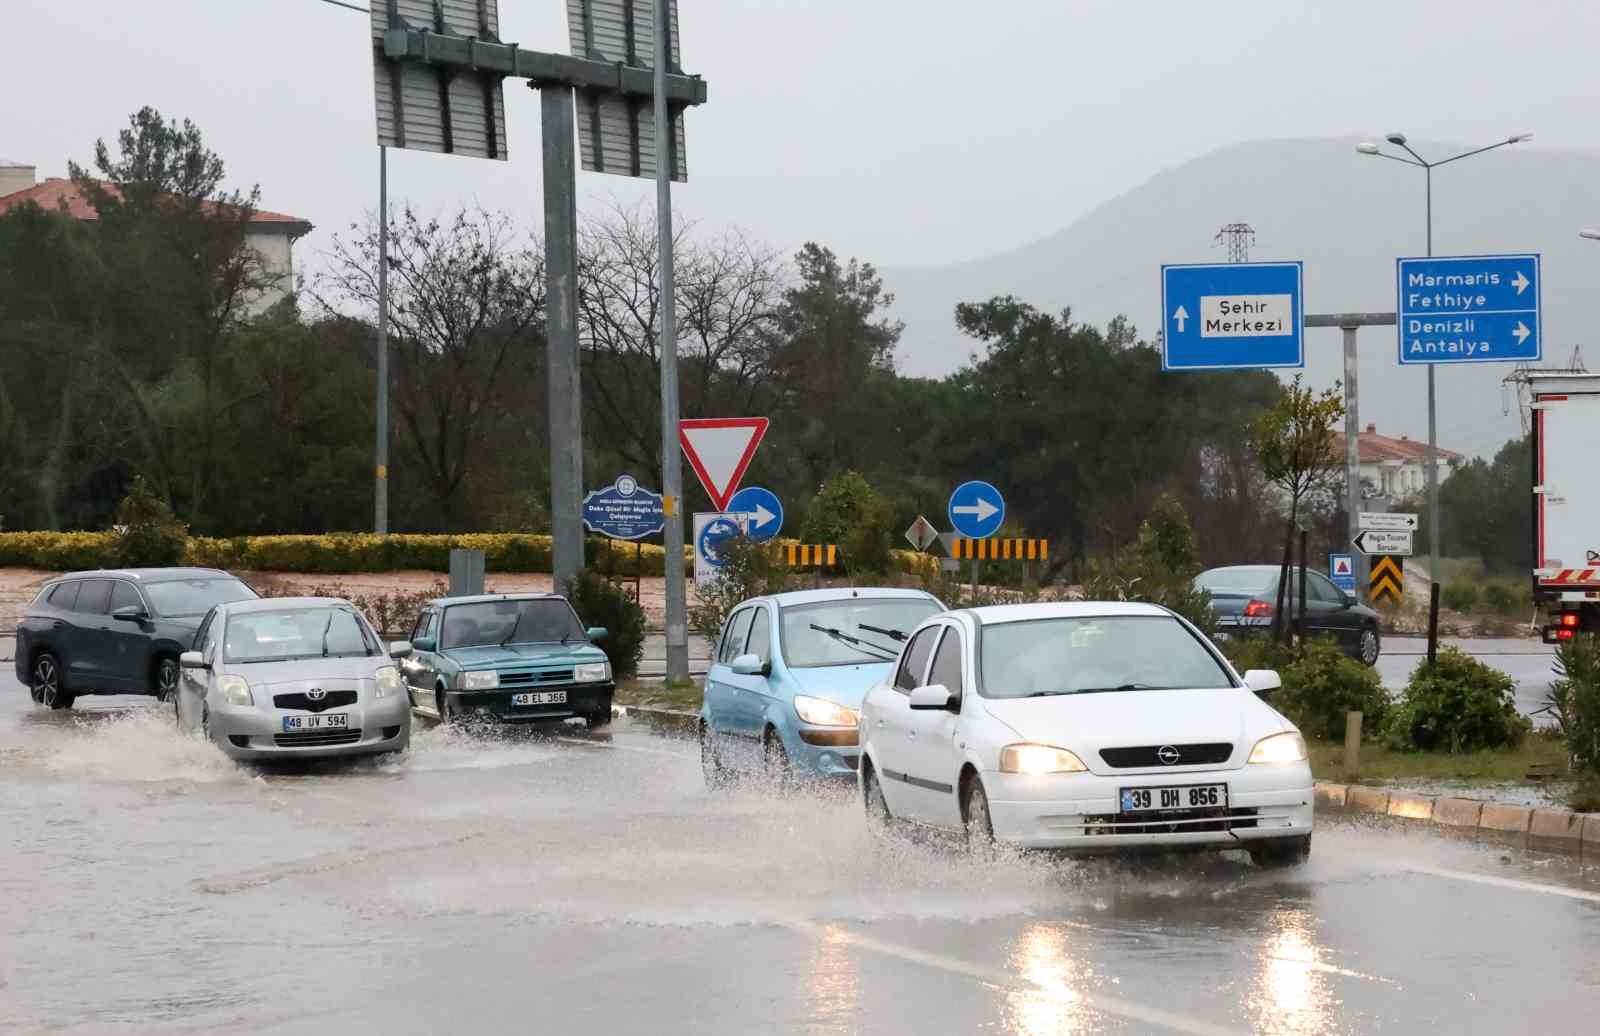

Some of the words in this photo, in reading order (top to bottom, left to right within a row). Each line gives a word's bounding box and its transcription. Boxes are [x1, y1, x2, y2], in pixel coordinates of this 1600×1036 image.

[1408, 271, 1501, 287] Marmaris
[1220, 300, 1268, 316] Şehir
[1408, 292, 1487, 310] Fethiye
[1206, 319, 1283, 333] Merkezi
[1409, 318, 1475, 334] Denizli
[1410, 338, 1491, 356] Antalya
[532, 694, 544, 703] EL
[289, 718, 302, 728] 48
[328, 716, 346, 726] 594
[1132, 790, 1152, 808] 39
[1161, 790, 1180, 808] DH
[1189, 787, 1218, 806] 856
